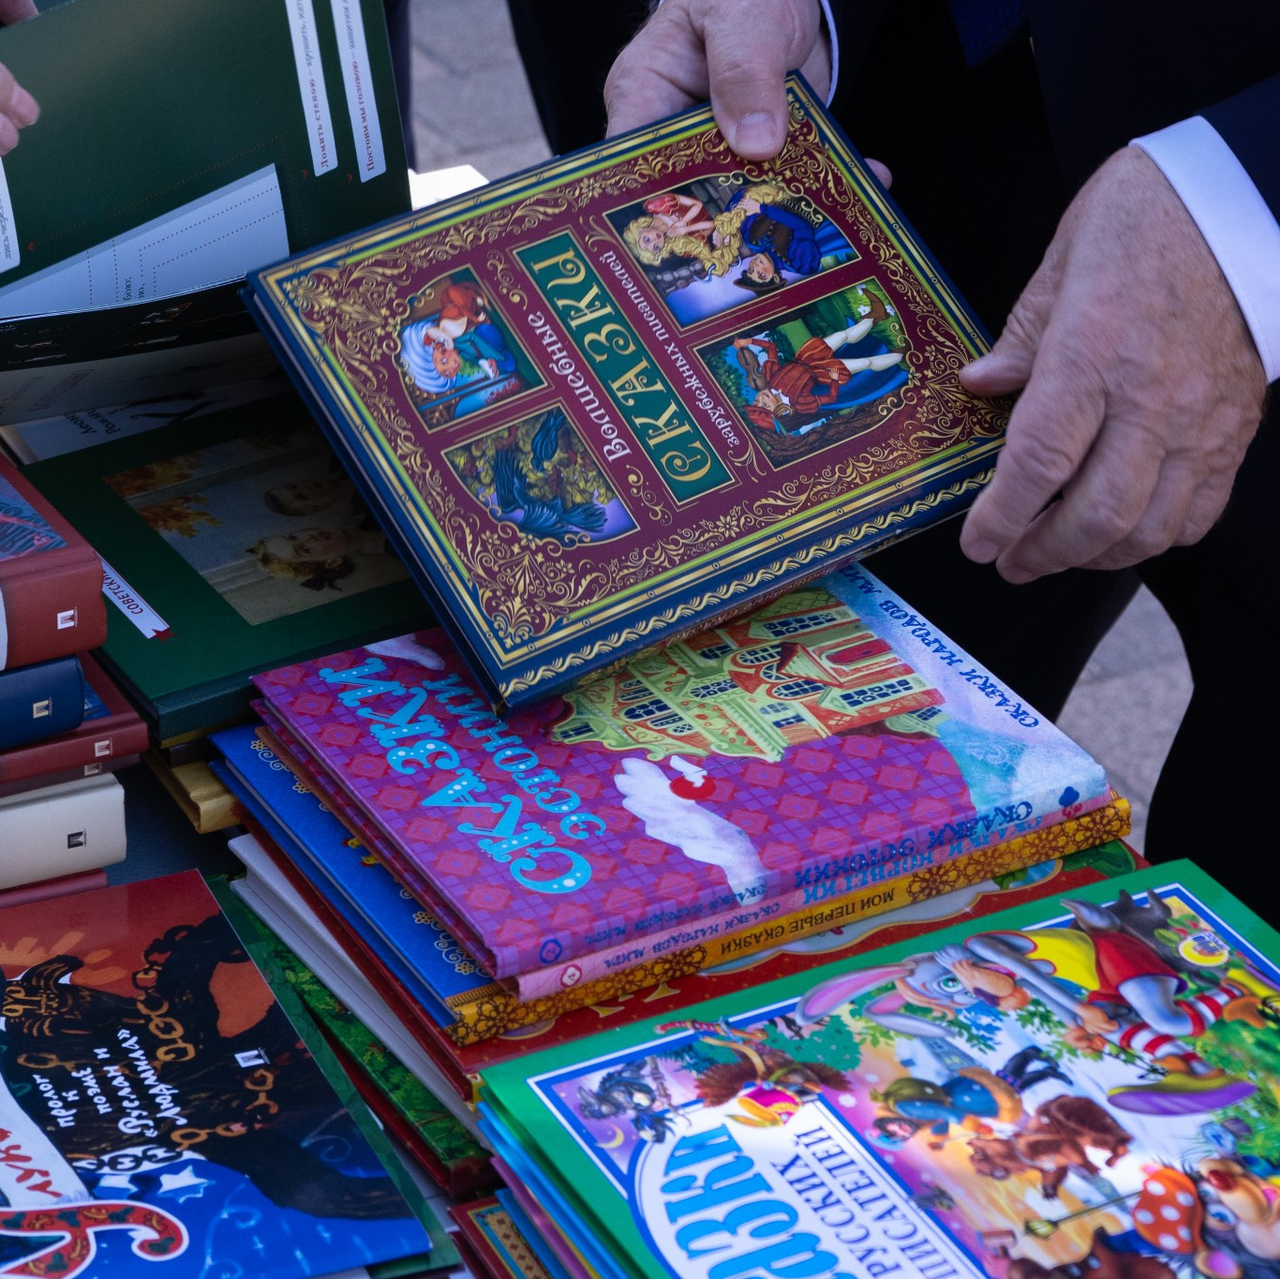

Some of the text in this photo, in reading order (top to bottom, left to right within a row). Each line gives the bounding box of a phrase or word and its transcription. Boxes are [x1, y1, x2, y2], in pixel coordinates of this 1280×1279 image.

[352, 60, 366, 104] головою
[316, 124, 329, 168] Ломить
[363, 122, 375, 171] Постоим
[530, 248, 712, 482] СКАЗКИ
[599, 249, 740, 447] зарубежных писателей
[527, 310, 632, 463] Волшебные
[103, 570, 144, 615] СОВЕТСКИ
[879, 599, 963, 666] НАРОДОВ
[959, 668, 1040, 728] СКАЗКИ
[319, 658, 593, 894] СКАЗКИ
[423, 673, 607, 840] ЭСТОНИИ
[721, 887, 896, 955] МОИ ПЕРВЫЕ СКАЗКИ
[95, 1048, 110, 1059] и
[32, 1073, 75, 1128] пролог
[62, 1090, 79, 1102] к
[770, 1154, 902, 1279] РУССКИХ
[794, 1126, 958, 1279] ПИСАТЕЛЕЙ
